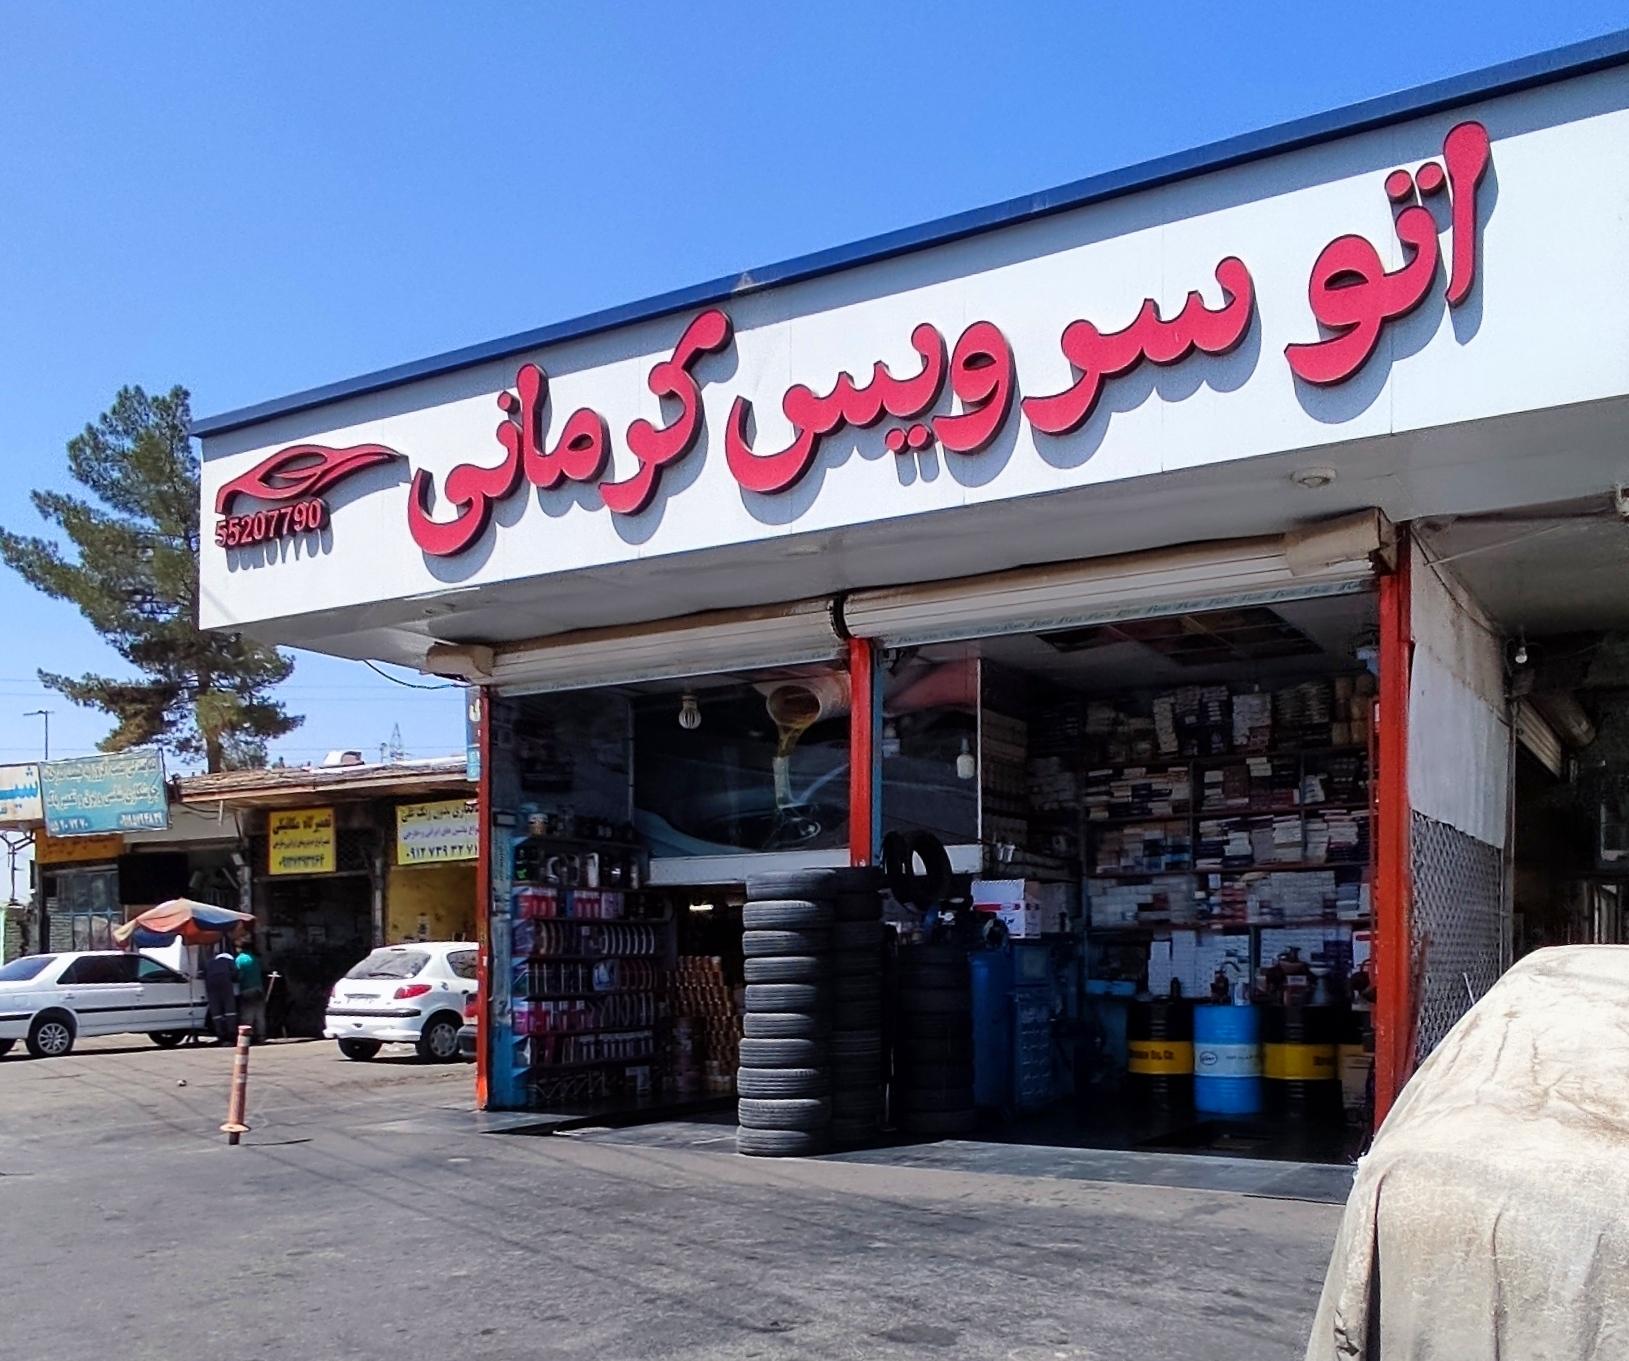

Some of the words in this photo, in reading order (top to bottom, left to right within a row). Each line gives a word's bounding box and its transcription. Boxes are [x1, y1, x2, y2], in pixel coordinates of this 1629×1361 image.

[725, 257, 1256, 493] سرویس
[1286, 122, 1492, 387] اتو
[215, 498, 325, 547] 55207790
[408, 308, 733, 557] کرمانی
